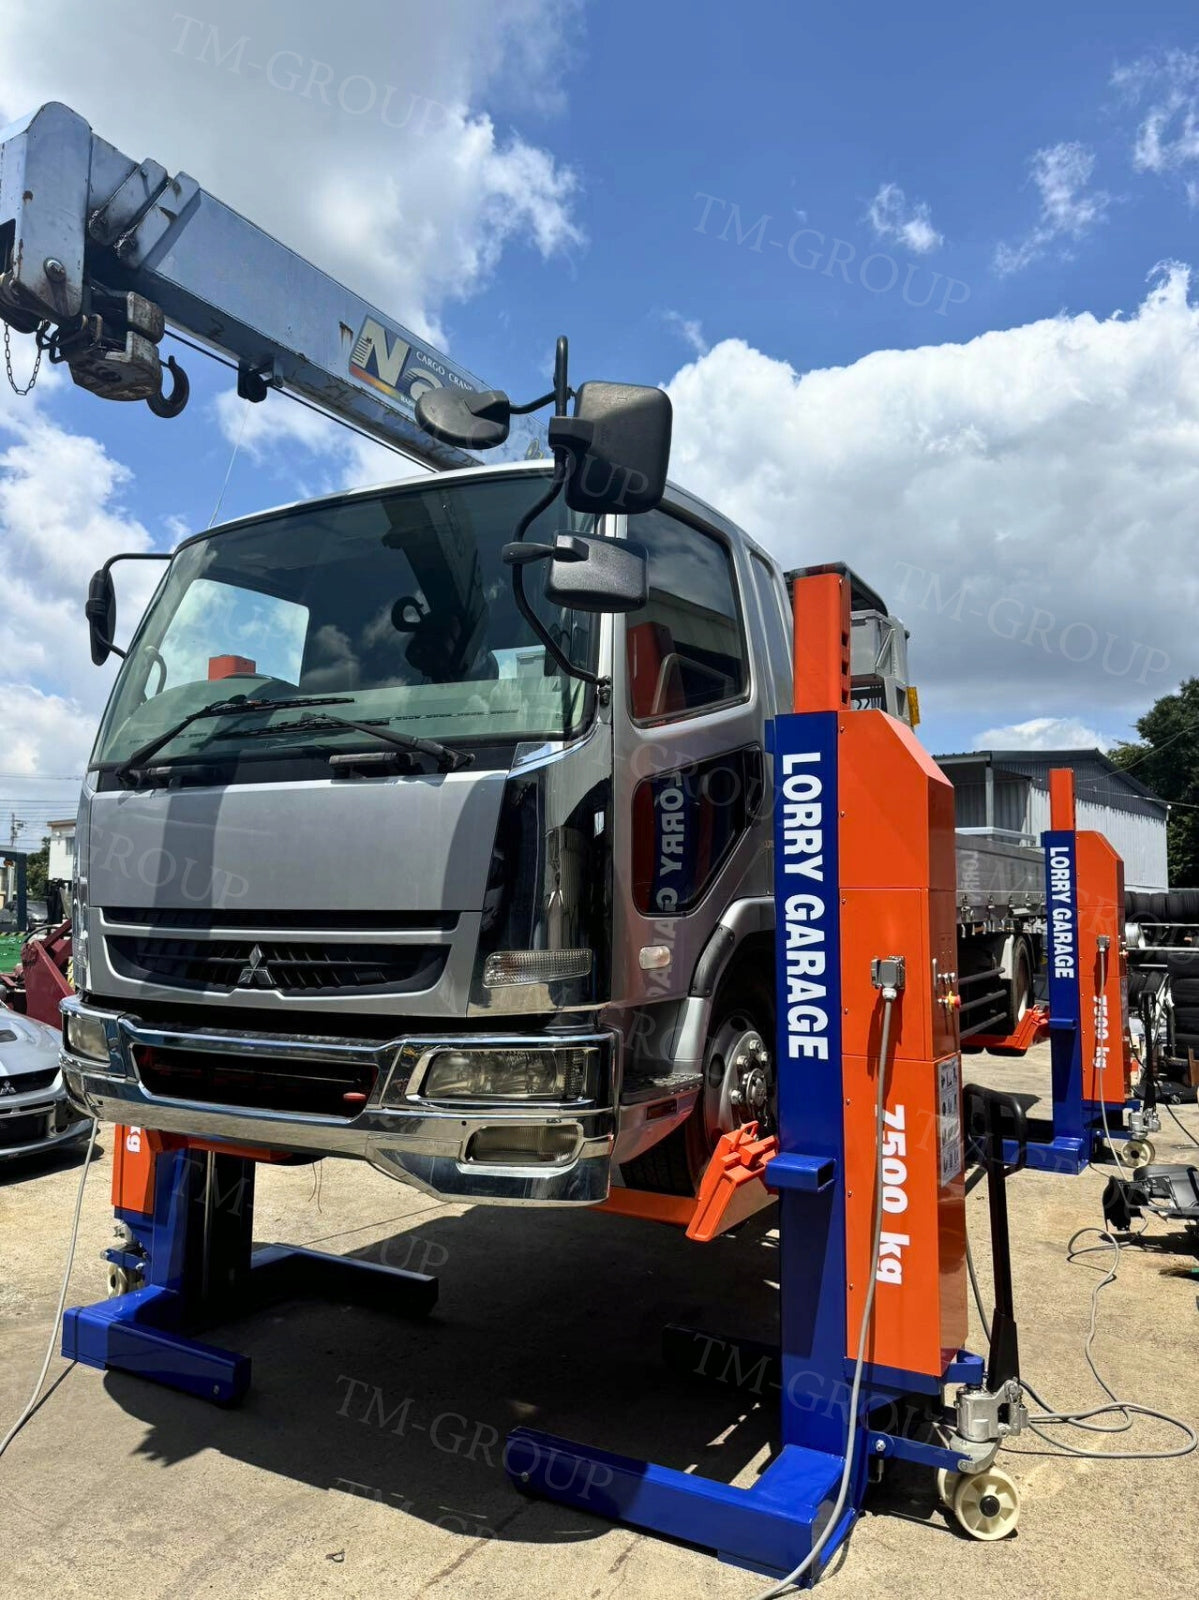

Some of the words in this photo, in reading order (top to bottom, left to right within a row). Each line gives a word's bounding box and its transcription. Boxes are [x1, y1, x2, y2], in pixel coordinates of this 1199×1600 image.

[416, 351, 446, 376] CARGO
[782, 752, 824, 882] LORRY
[1050, 847, 1070, 904] LORRY
[784, 894, 829, 1060] GARAGE
[1052, 907, 1074, 979] GARAGE
[875, 1104, 909, 1214] 7500
[875, 1231, 911, 1286] kg
